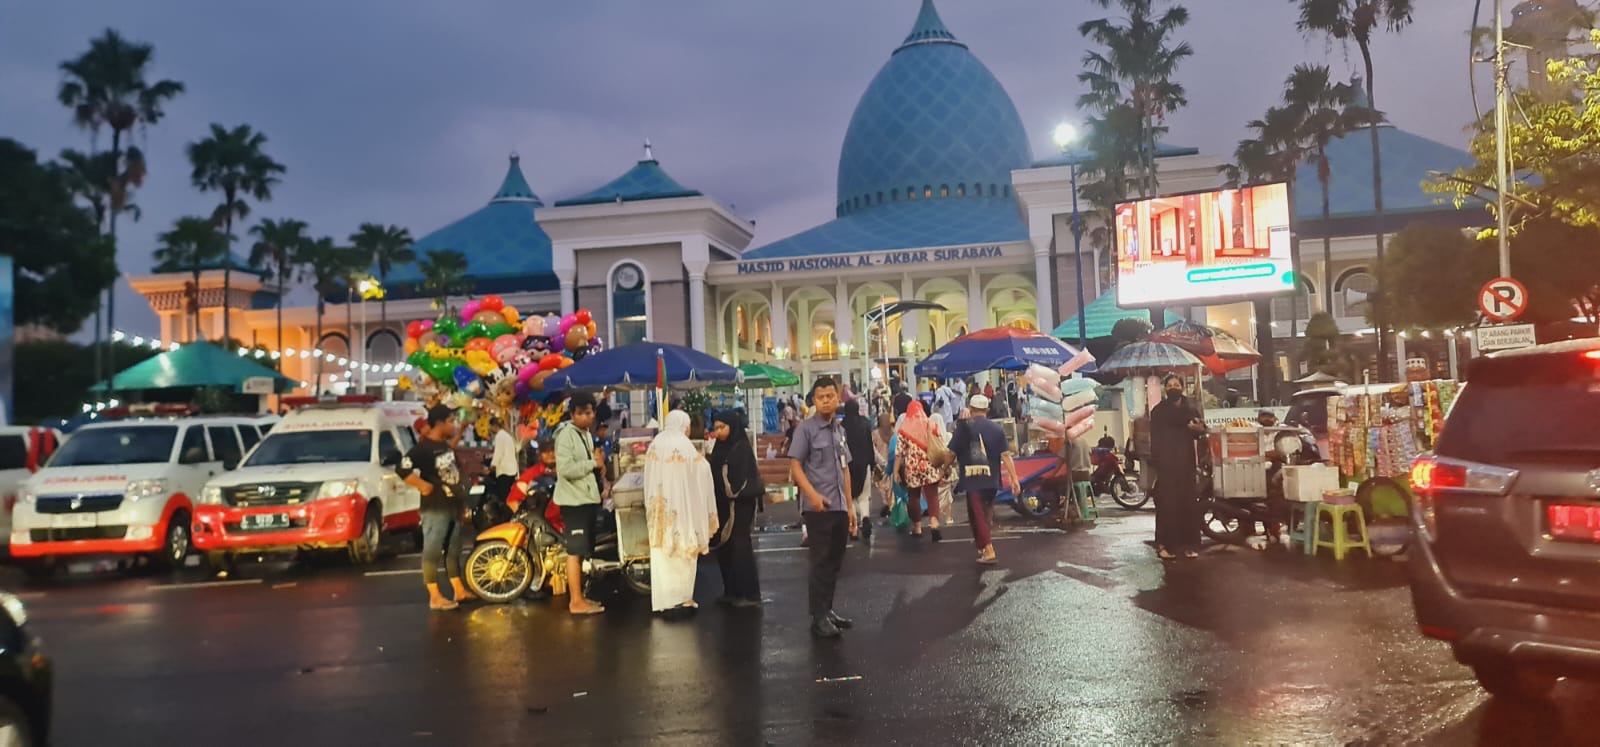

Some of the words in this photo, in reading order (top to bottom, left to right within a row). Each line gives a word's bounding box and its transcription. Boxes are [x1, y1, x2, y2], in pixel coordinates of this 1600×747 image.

[737, 261, 784, 275] MASJID
[789, 256, 852, 271] NASIONAL
[858, 255, 873, 267] AL
[883, 251, 929, 265] AKBAR
[934, 245, 1003, 261] SURABAYA
